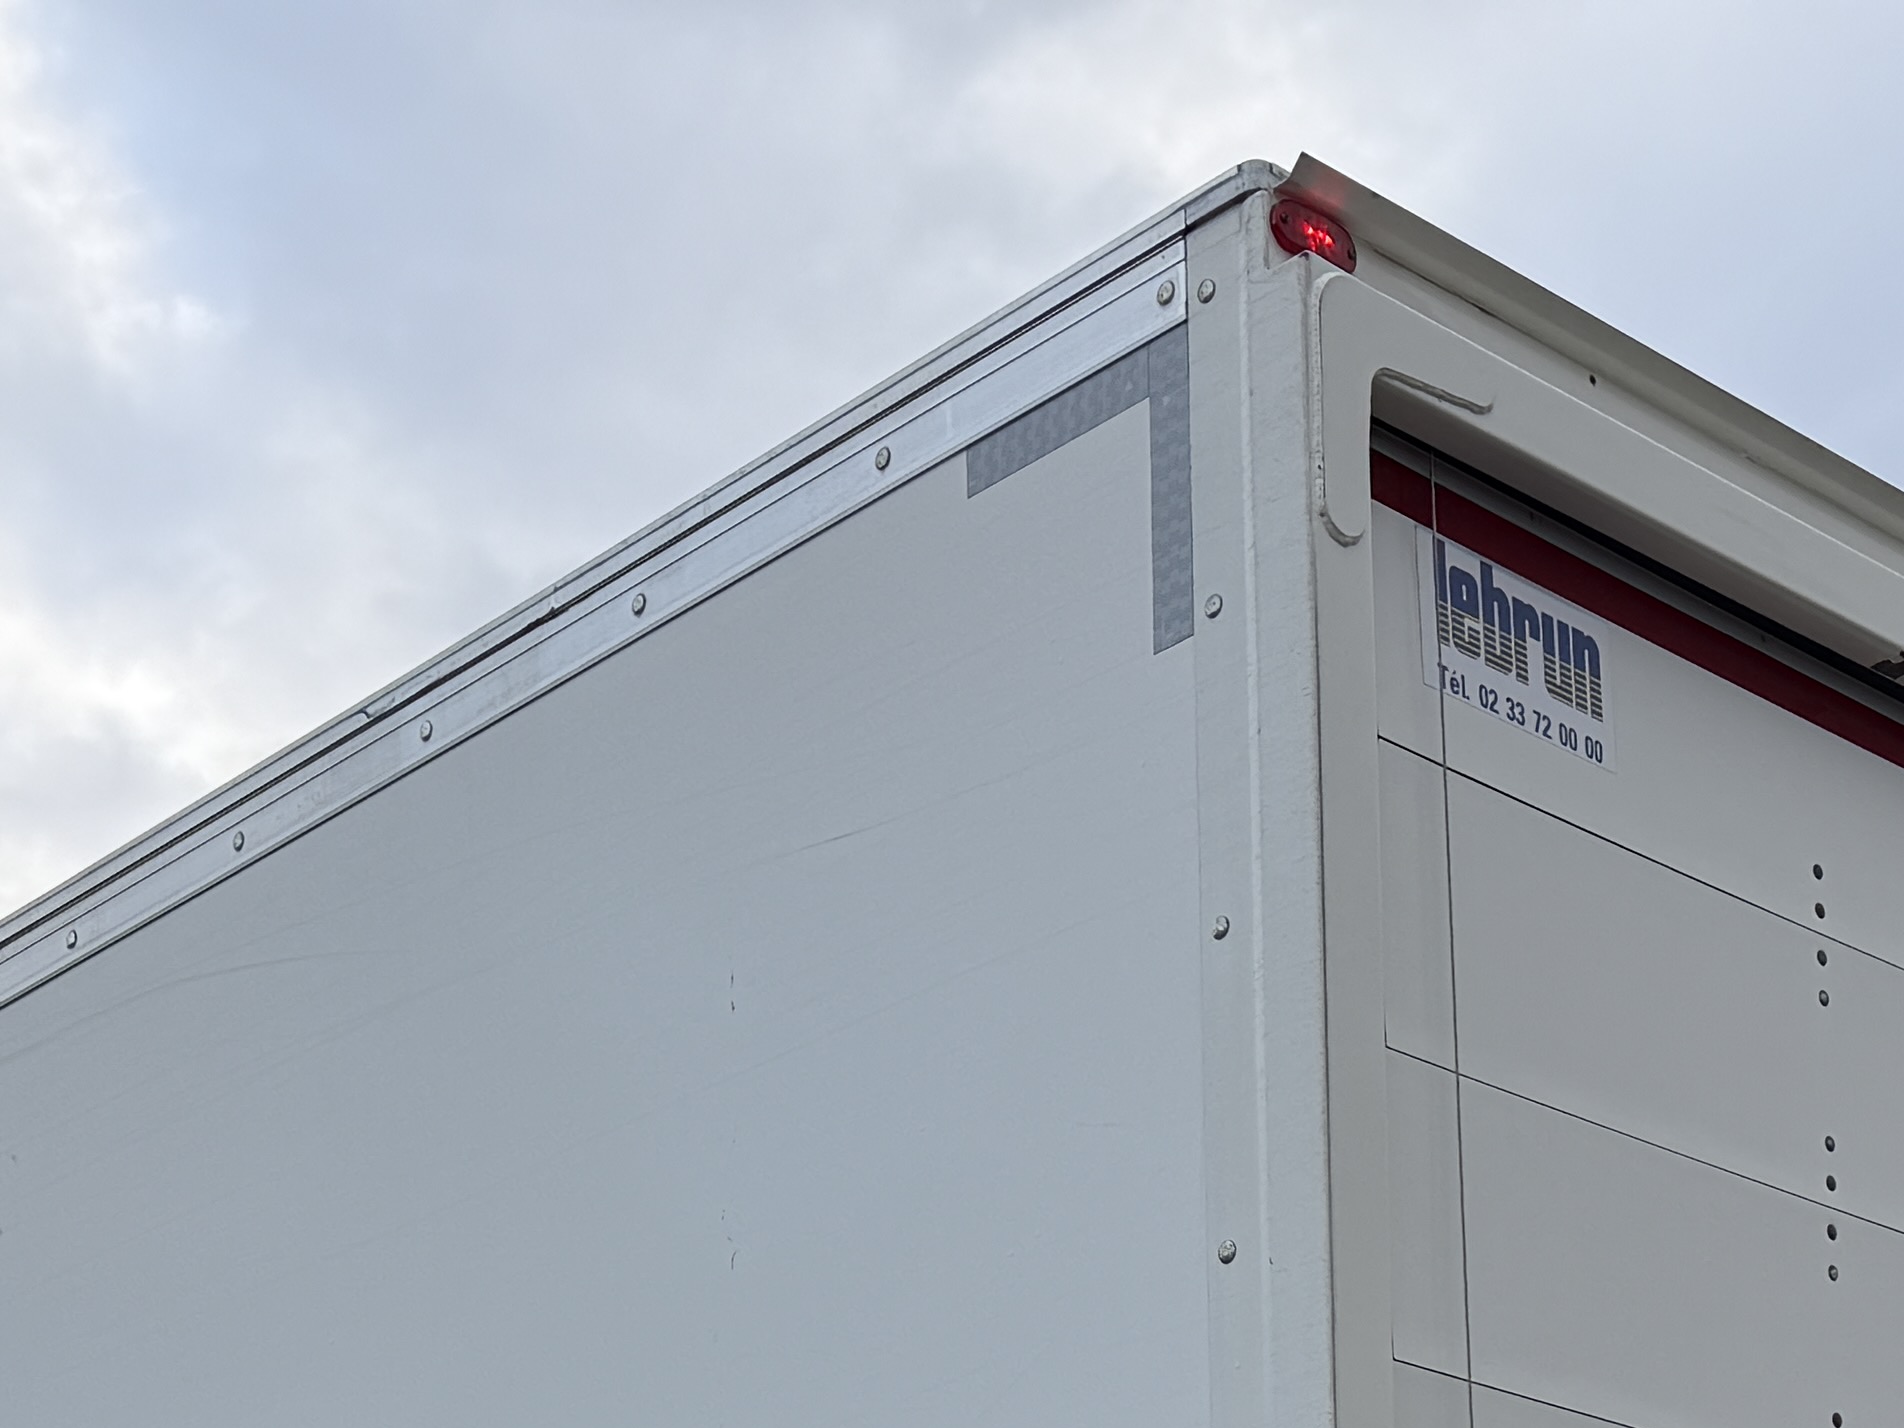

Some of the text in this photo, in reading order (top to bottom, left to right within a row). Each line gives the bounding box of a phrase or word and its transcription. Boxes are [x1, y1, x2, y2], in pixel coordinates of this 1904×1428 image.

[1436, 538, 1603, 723] lebrun
[1479, 684, 1499, 714] 02
[1506, 697, 1525, 726] 33
[1533, 709, 1552, 739] 72
[1559, 722, 1577, 751] 00
[1585, 736, 1603, 763] 00
